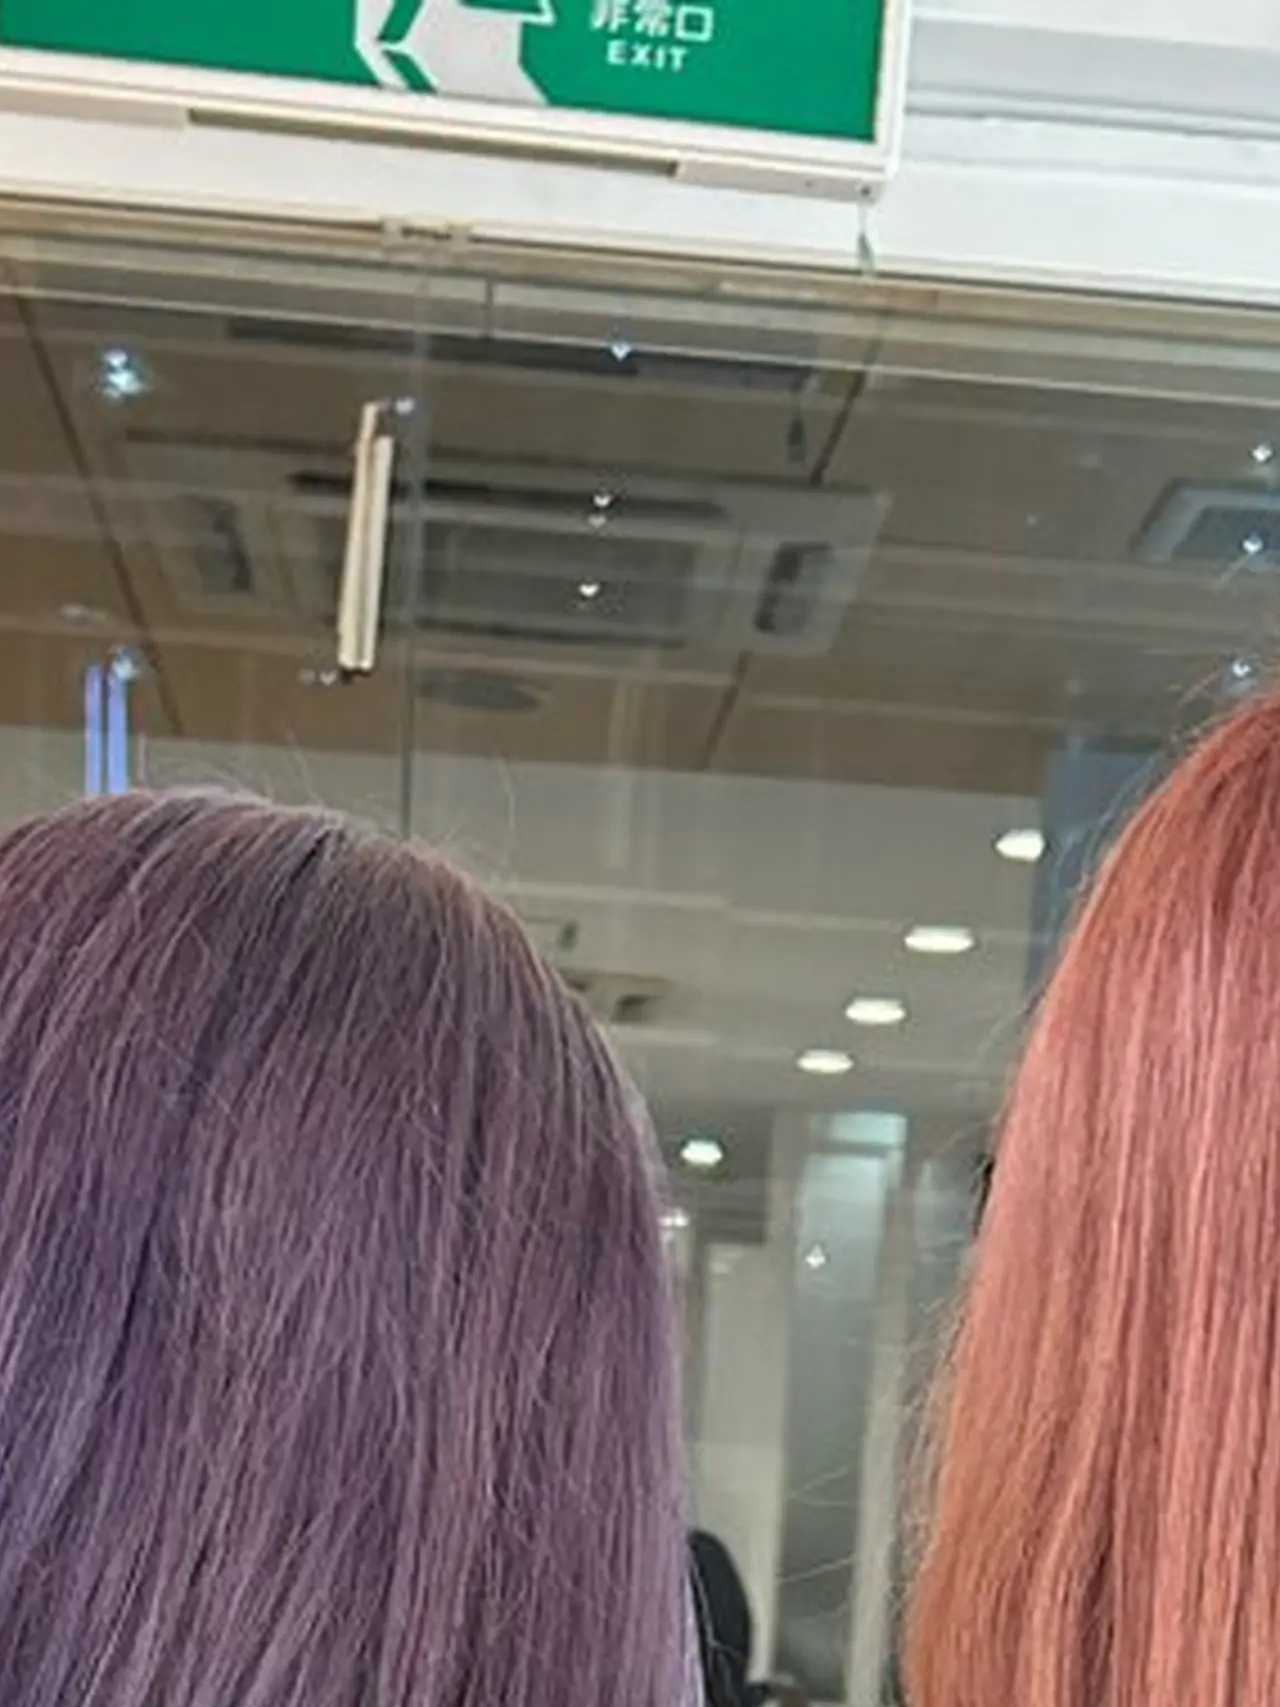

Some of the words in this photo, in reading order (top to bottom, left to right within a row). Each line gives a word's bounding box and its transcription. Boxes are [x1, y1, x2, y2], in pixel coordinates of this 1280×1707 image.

[590, 0, 714, 43] 非常口
[606, 40, 689, 72] EXIT
